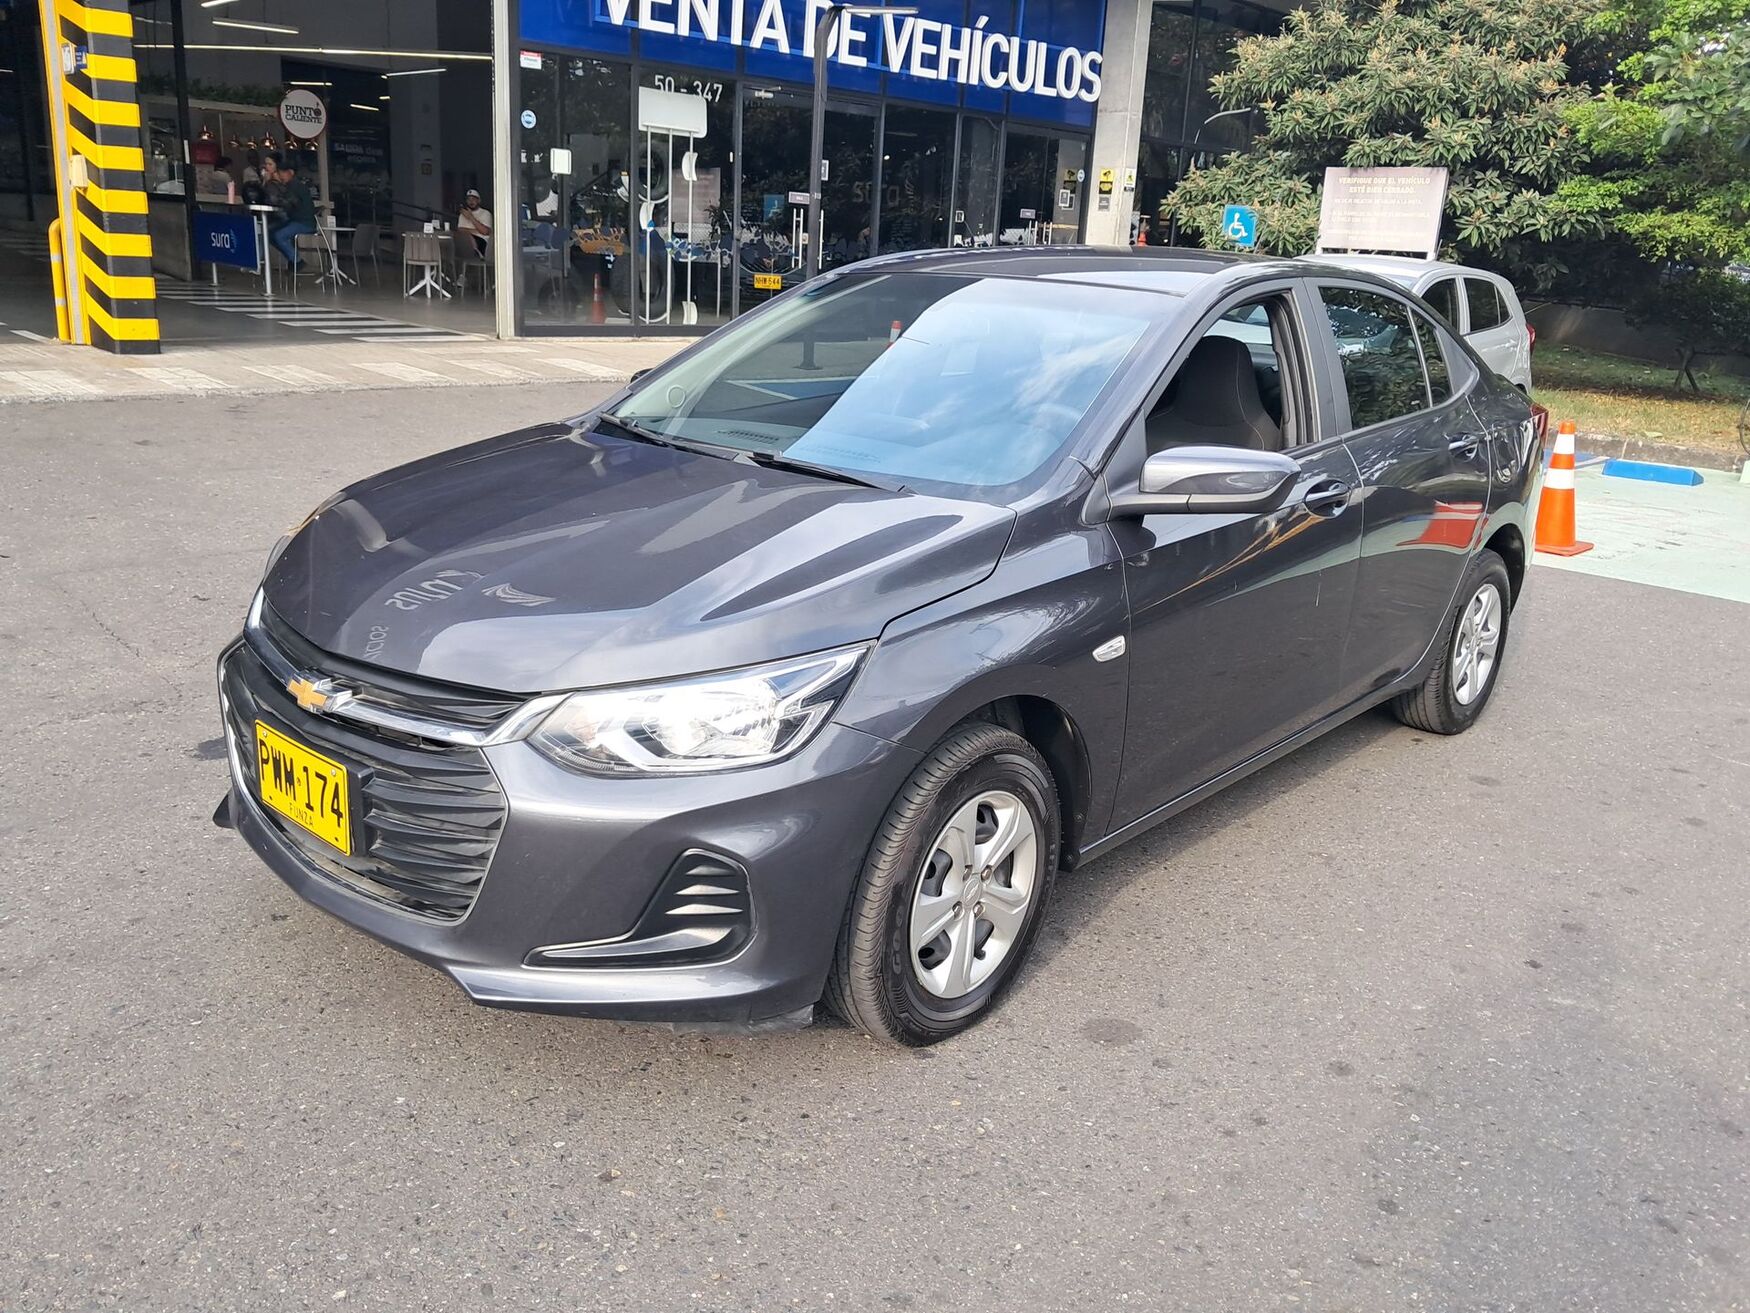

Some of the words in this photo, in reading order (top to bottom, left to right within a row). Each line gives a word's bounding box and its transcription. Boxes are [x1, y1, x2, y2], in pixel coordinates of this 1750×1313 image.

[803, 0, 868, 67] DE
[883, 13, 1104, 103] VEHÍCULOS
[655, 74, 675, 93] 50
[693, 80, 723, 103] 347
[285, 114, 322, 124] CALIENTE
[1398, 175, 1431, 185] VEHÍCULO
[211, 232, 230, 248] sura
[289, 802, 314, 826] FUNZA
